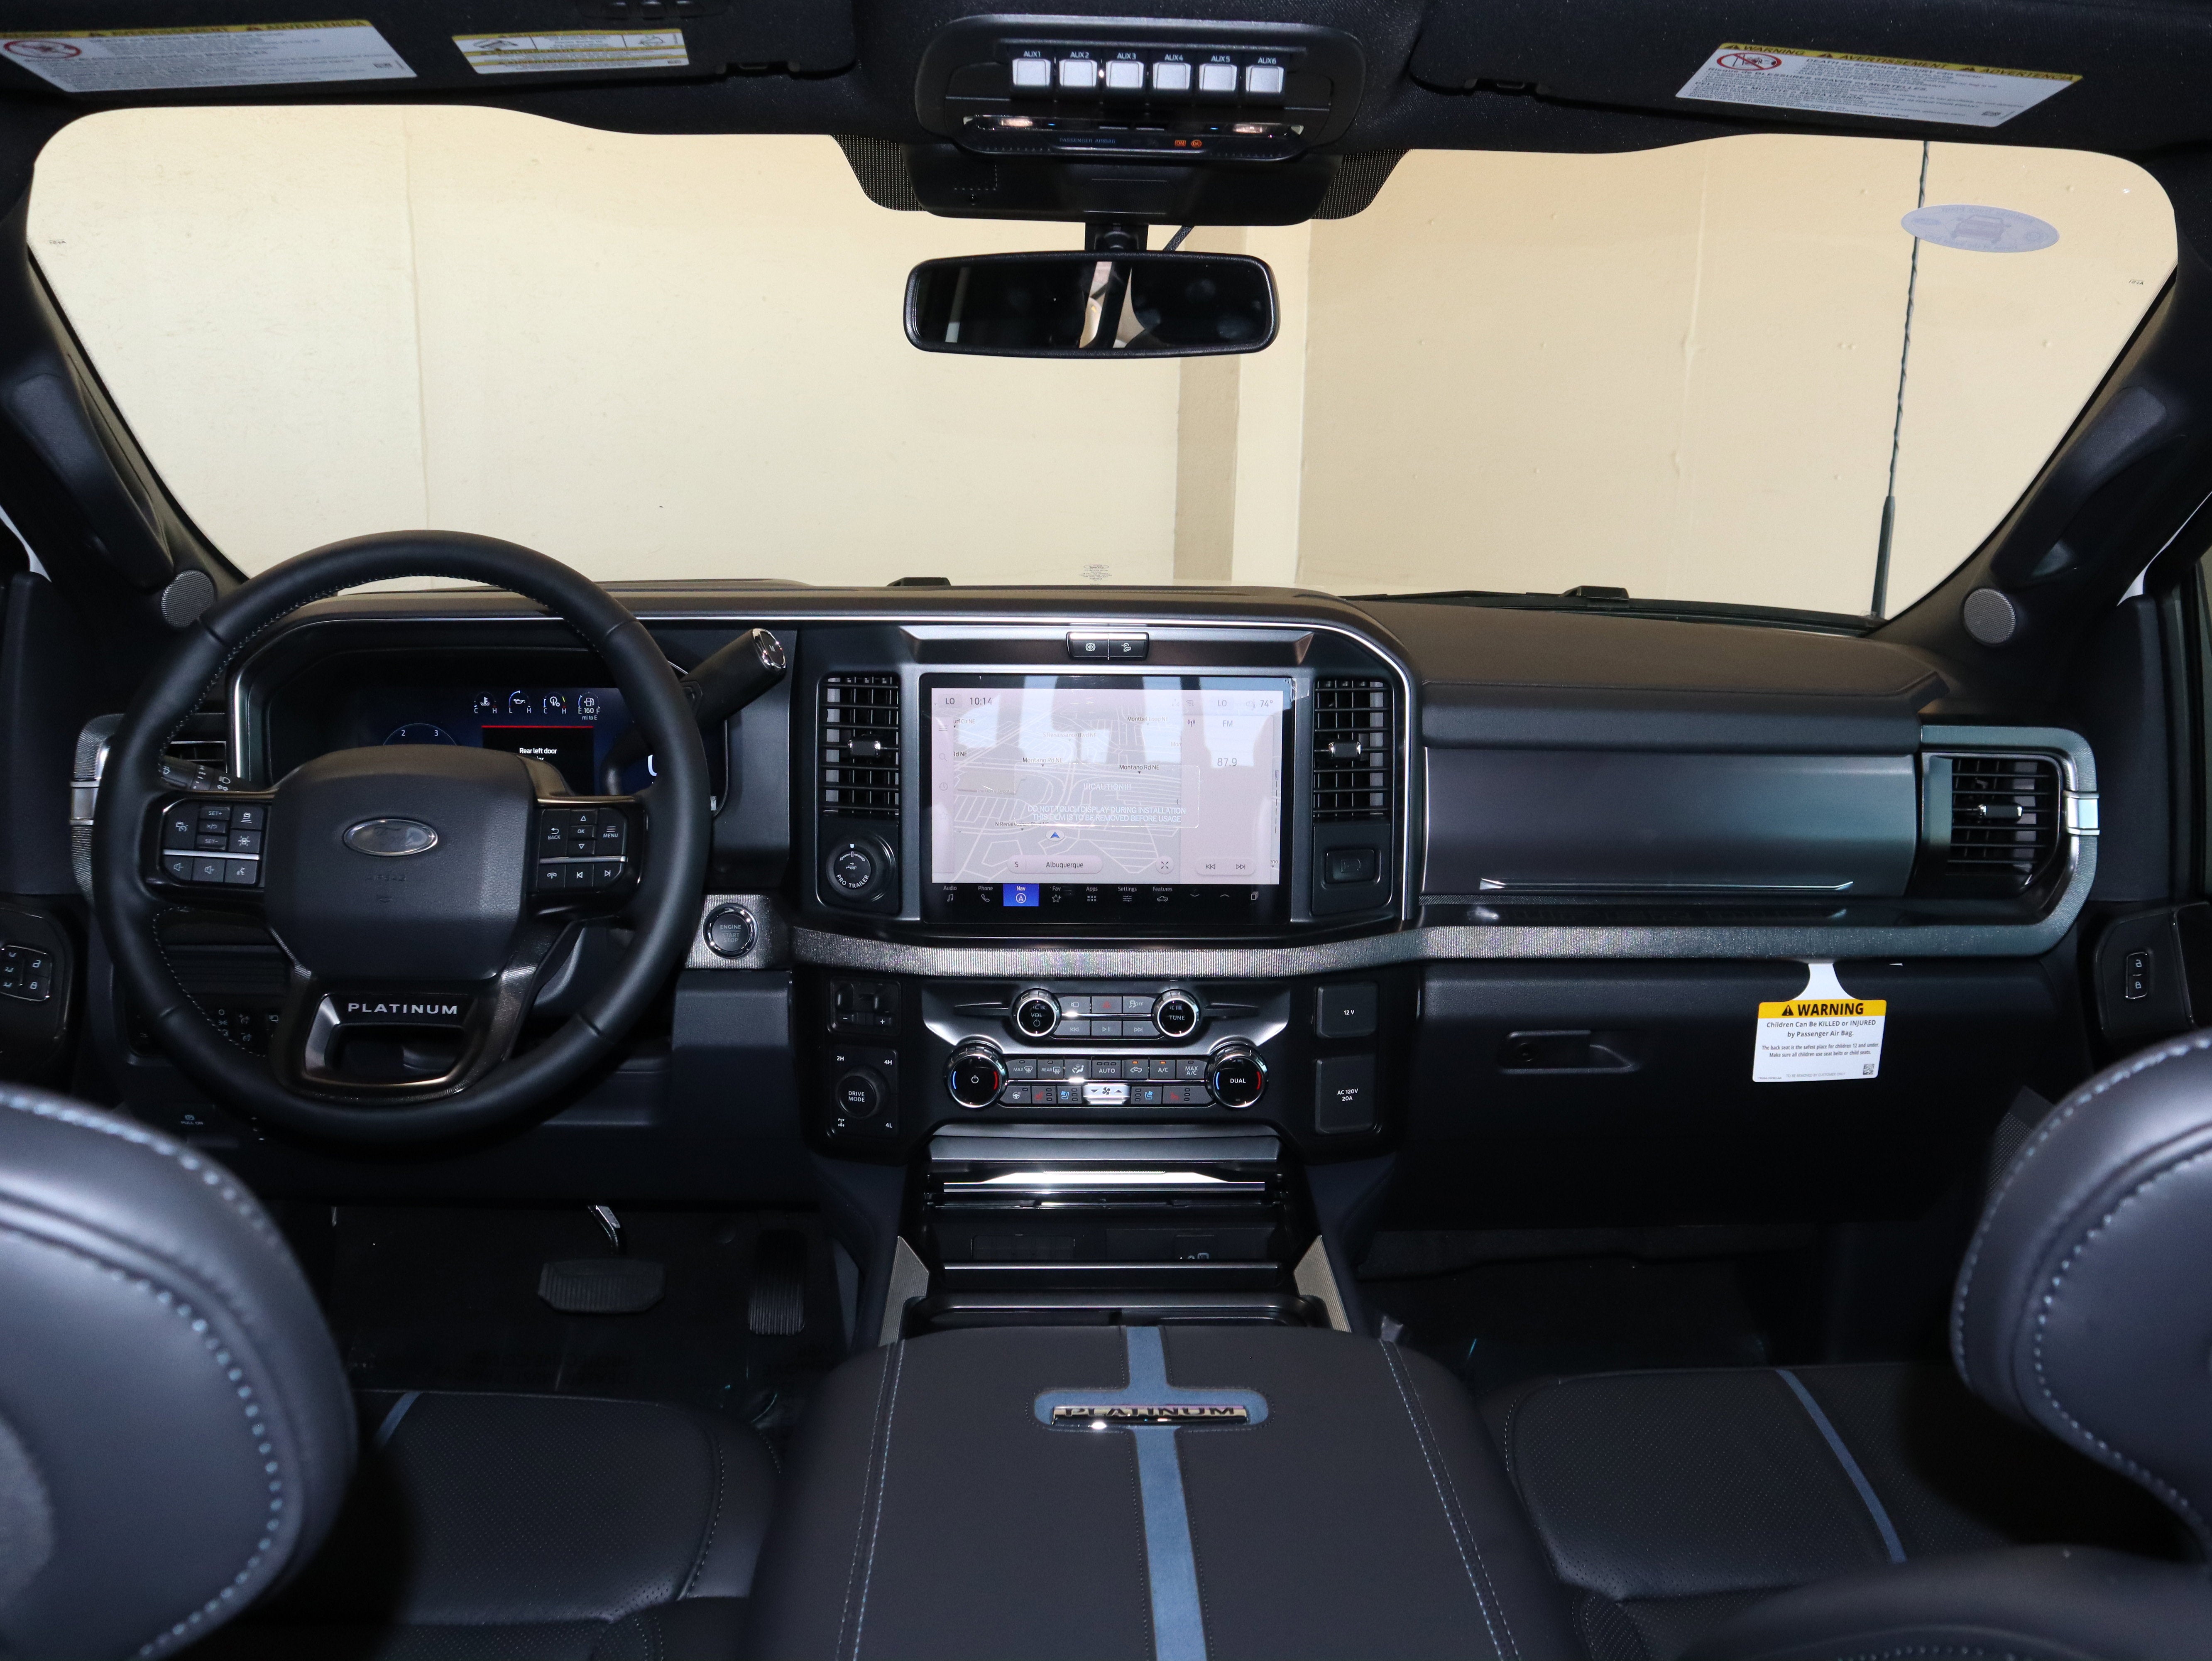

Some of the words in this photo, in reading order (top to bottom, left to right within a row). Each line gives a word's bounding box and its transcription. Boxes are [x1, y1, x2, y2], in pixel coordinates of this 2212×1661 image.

[1741, 46, 1806, 56] WARNING
[1217, 758, 1237, 767] 87.9
[836, 874, 847, 886] PRO
[849, 874, 870, 889] TRAILER
[348, 1003, 457, 1014] PLATINUM
[1798, 1003, 1864, 1016] WARNING
[1065, 1407, 1235, 1416] PLATINUM
